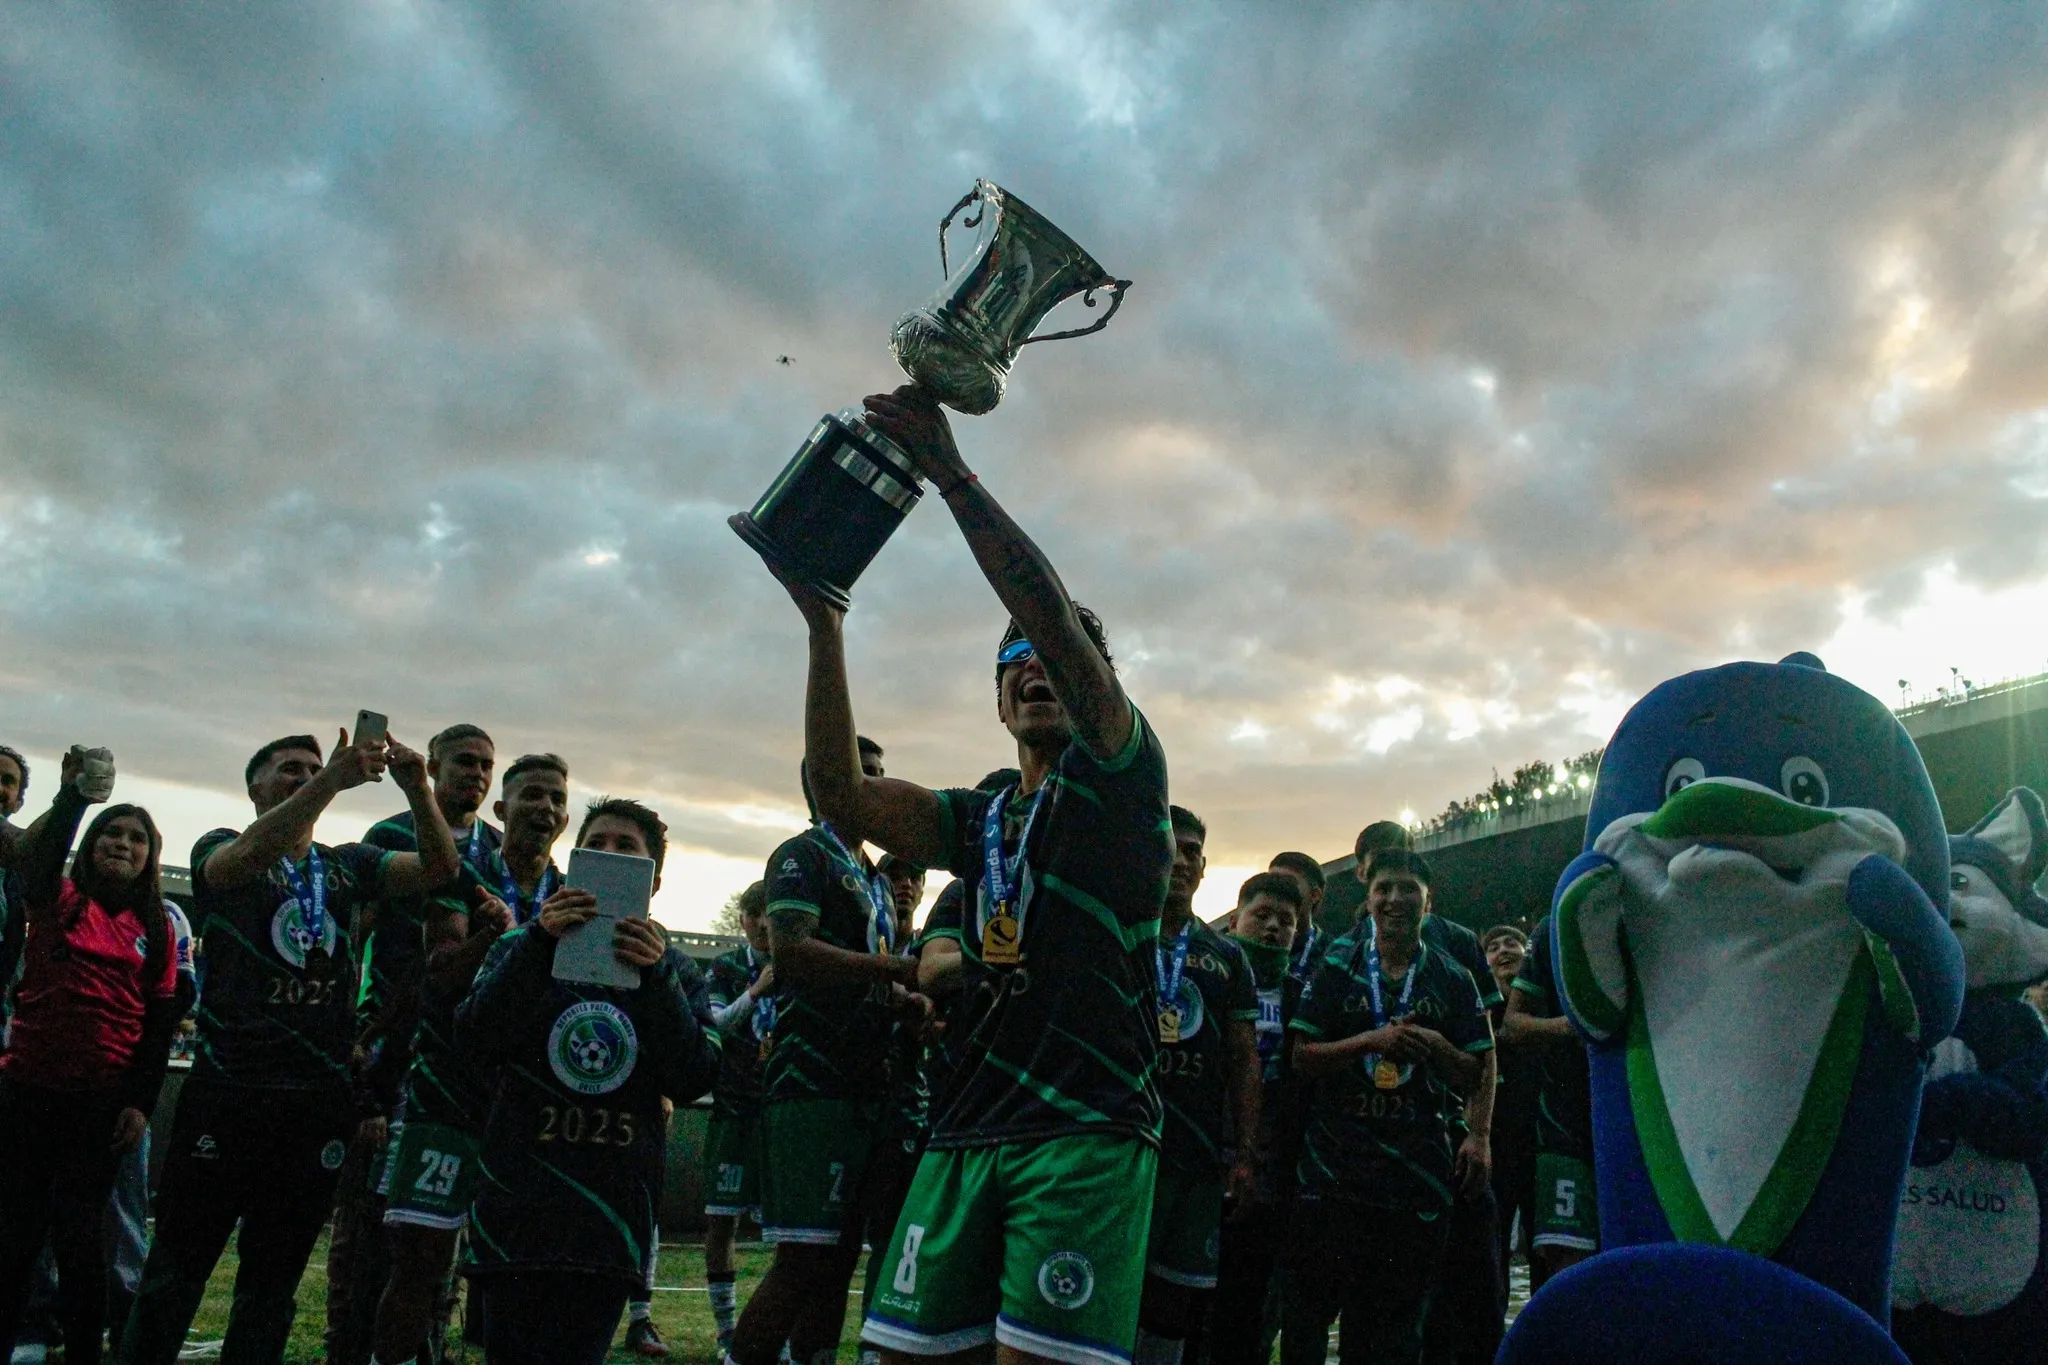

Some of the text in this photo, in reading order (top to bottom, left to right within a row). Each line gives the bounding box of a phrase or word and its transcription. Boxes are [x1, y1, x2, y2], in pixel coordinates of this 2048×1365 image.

[556, 1003, 588, 1029] DEPORTES
[538, 1106, 634, 1146] 2025
[415, 1148, 461, 1196] 29
[716, 1162, 744, 1193] 30
[828, 1161, 844, 1202] 2
[1555, 1179, 1576, 1217] 5
[1927, 1186, 2005, 1213] SALUD
[893, 1223, 925, 1295] 8
